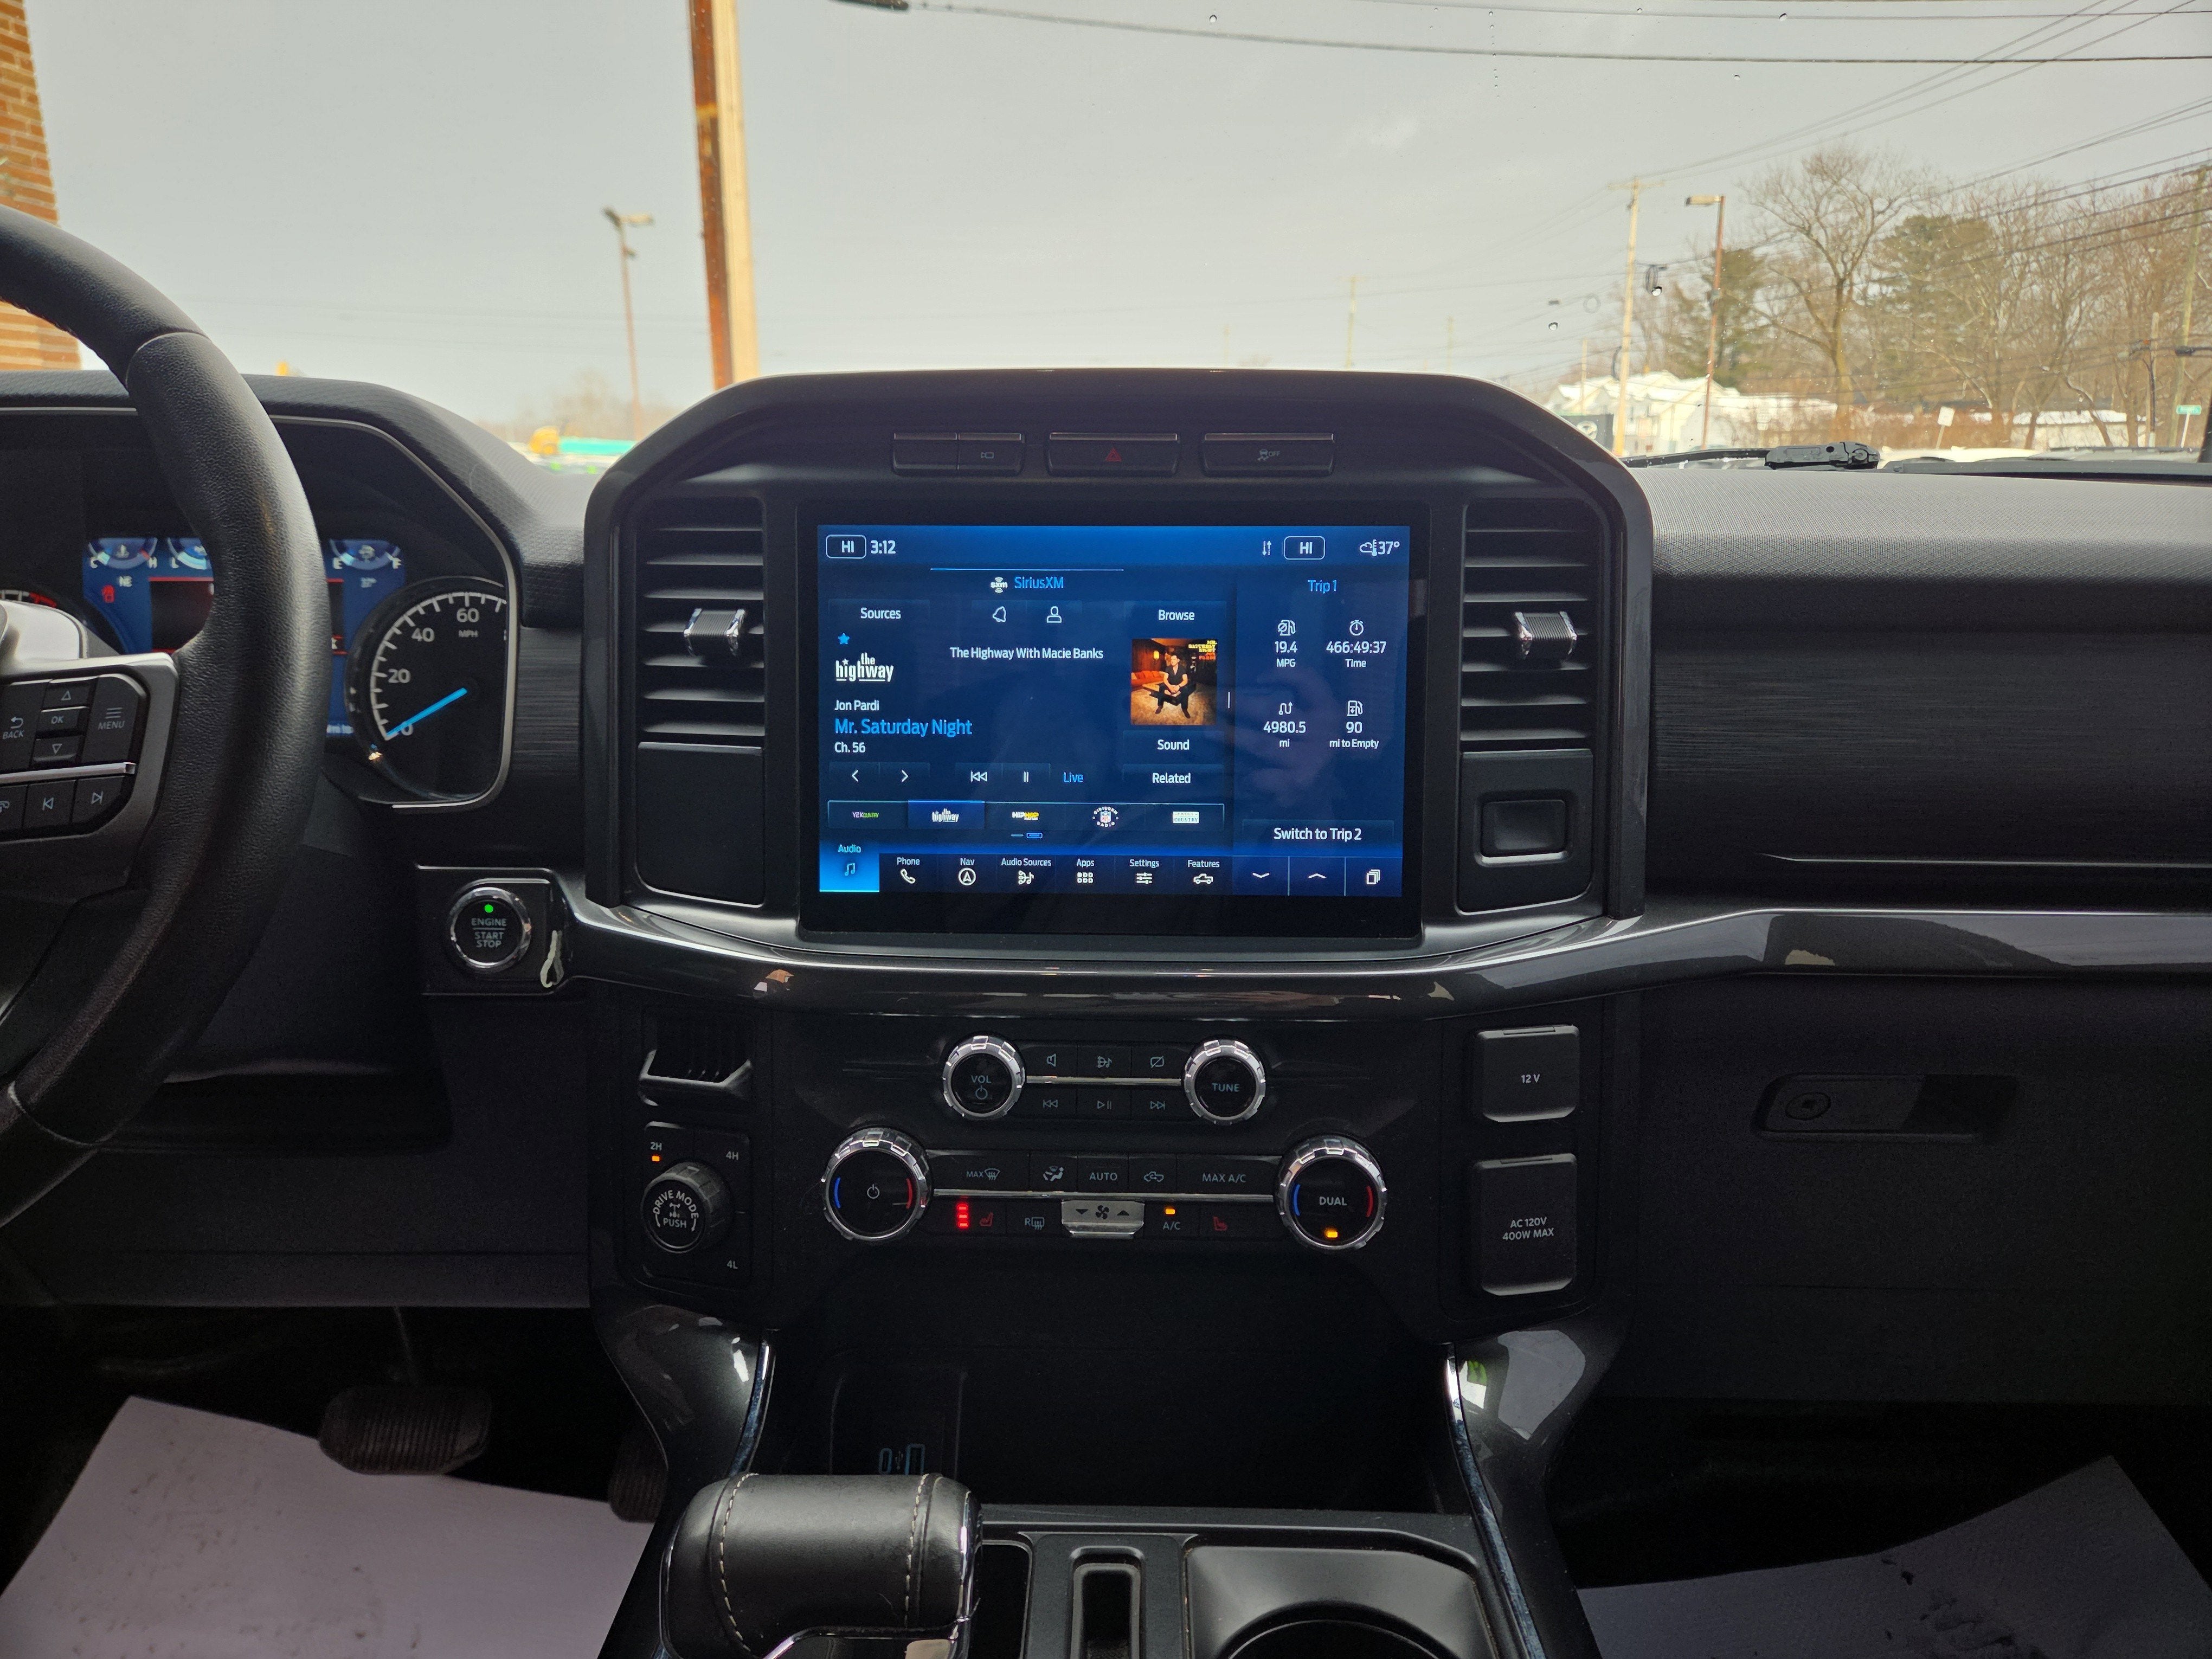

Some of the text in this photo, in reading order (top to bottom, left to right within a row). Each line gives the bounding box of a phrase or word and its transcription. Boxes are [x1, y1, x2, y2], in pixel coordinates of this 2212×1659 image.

[841, 541, 854, 553] HI
[870, 540, 896, 555] 3:12
[1300, 542, 1313, 555] HI
[1378, 541, 1400, 555] 37°
[1014, 576, 1064, 589] SiriusXM
[1308, 580, 1338, 594] Trip 1
[456, 608, 480, 622] 60
[860, 607, 901, 620] Sources
[1158, 609, 1195, 621] Browse
[411, 627, 435, 642] 40
[459, 629, 479, 638] MPH
[1275, 640, 1298, 653] 19.4
[1326, 640, 1387, 653] 466:49:37
[861, 652, 876, 665] the
[950, 647, 1104, 660] The Highway With Macie Banks
[1276, 659, 1296, 668] MPG
[1345, 659, 1367, 668] Time
[388, 668, 411, 684] 20
[835, 659, 894, 682] highway
[834, 699, 879, 711] Jon Pardi
[51, 716, 65, 724] OK
[98, 721, 126, 730] MENU
[834, 718, 972, 738] Mr. Saturday Night
[1263, 721, 1307, 734] 4980.5
[1346, 721, 1363, 734] 90
[2, 730, 25, 740] BACK
[834, 742, 866, 754] Ch. 56
[1157, 739, 1189, 751] Sound
[1279, 738, 1290, 748] mi
[1329, 739, 1379, 750] mi to Empty
[1063, 772, 1084, 783] Live
[1152, 773, 1191, 784] Related
[1274, 827, 1362, 842] Switch to Trip 2
[838, 844, 861, 854] Audio
[896, 857, 921, 866] Phone
[960, 857, 975, 866] Nav
[1001, 858, 1052, 867] Audio Sources
[1076, 858, 1095, 869] Apps
[1129, 859, 1160, 869] Settings
[1187, 859, 1220, 869] Features
[471, 918, 507, 926] ENGINE
[474, 931, 504, 940] START
[476, 940, 502, 948] STOP
[971, 1075, 992, 1084] VOL
[1521, 1073, 1541, 1083] 12 V
[1212, 1083, 1240, 1093] TUNE
[650, 1141, 662, 1151] 2H
[725, 1151, 739, 1161] 4H
[966, 1170, 984, 1178] MAX
[1089, 1172, 1118, 1181] AUTO
[1202, 1173, 1246, 1184] MAX A/C
[653, 1190, 699, 1219] DRIVE MODE
[1319, 1196, 1348, 1207] DUAL
[663, 1218, 687, 1229] PUSH
[1162, 1221, 1181, 1231] A/C
[1510, 1217, 1547, 1229] AC 120V
[1502, 1227, 1554, 1241] 400W MAX
[726, 1261, 738, 1269] 4L
